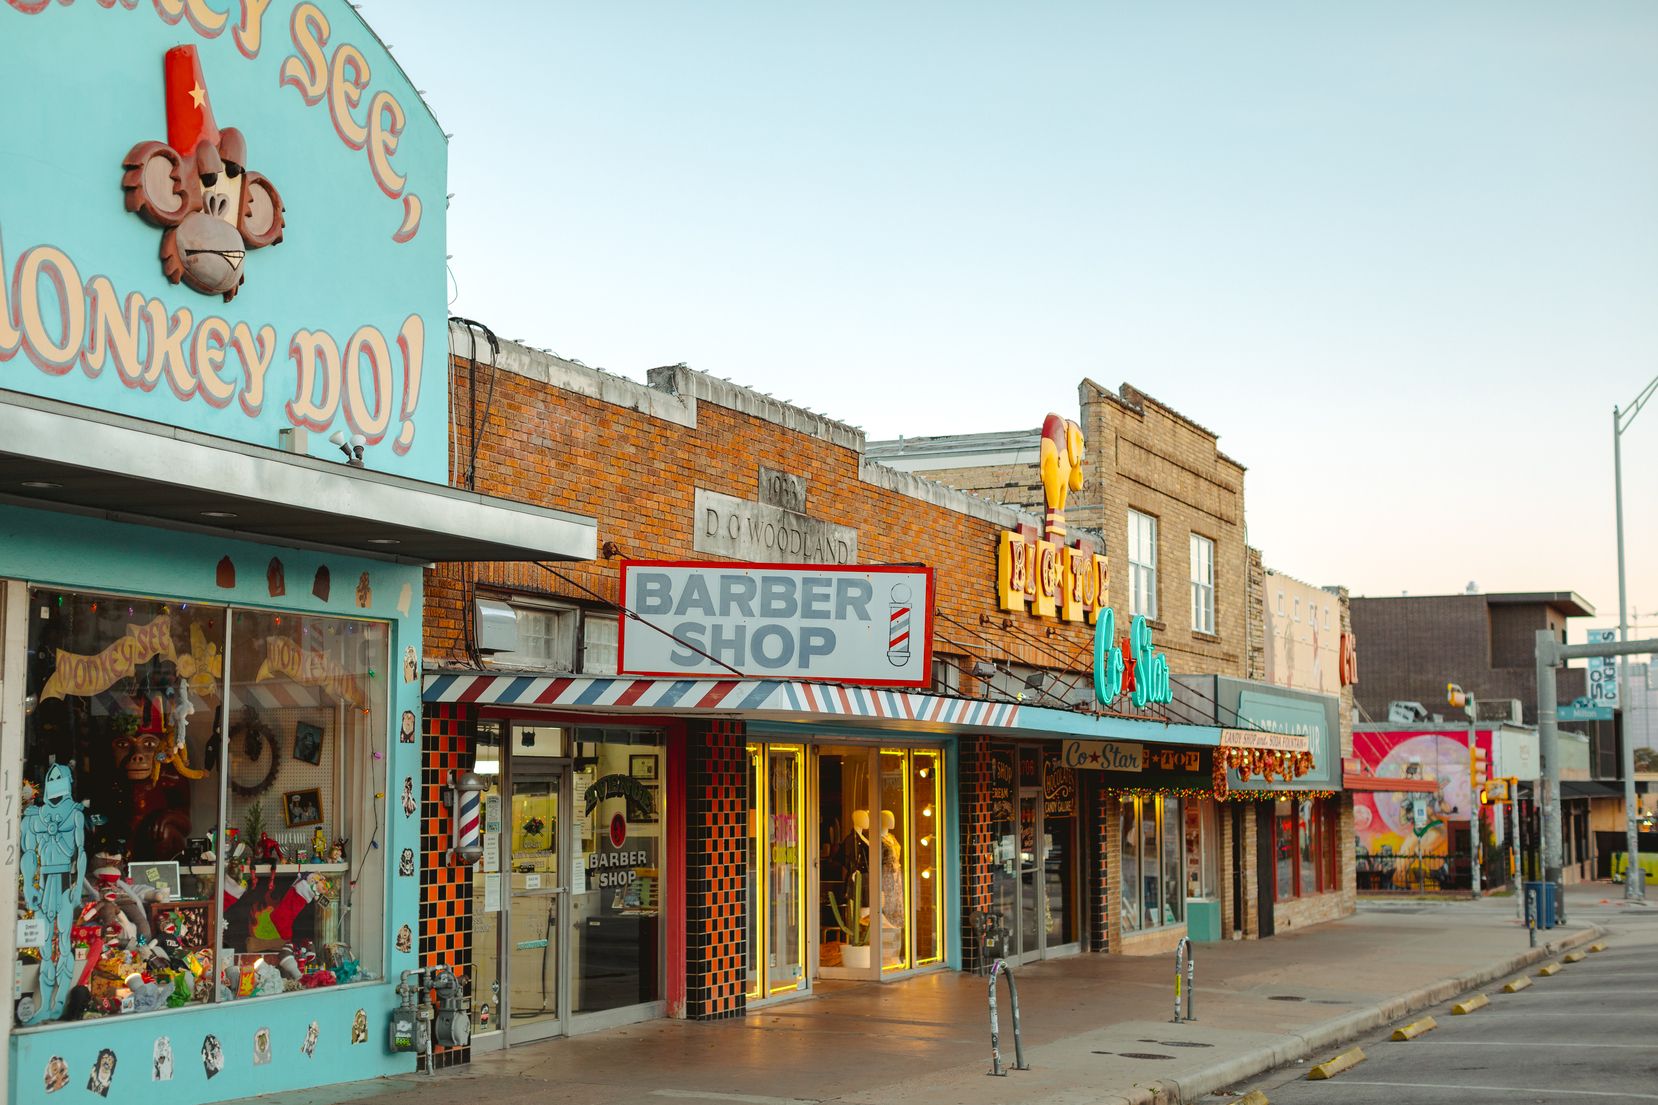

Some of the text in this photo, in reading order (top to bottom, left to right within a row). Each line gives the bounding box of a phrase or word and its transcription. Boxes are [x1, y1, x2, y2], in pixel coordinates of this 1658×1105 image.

[0, 224, 425, 456] ONKEY DO!
[747, 518, 849, 565] WOODLAND
[635, 573, 874, 621] BARBER
[1011, 540, 1111, 607] BIG TOP
[137, 620, 169, 661] SEE
[669, 622, 836, 669] SHOP
[1094, 606, 1173, 708] Co Star
[1065, 741, 1088, 768] Co
[1101, 743, 1140, 769] Star
[590, 850, 648, 869] BARBER
[600, 870, 637, 888] SHOP
